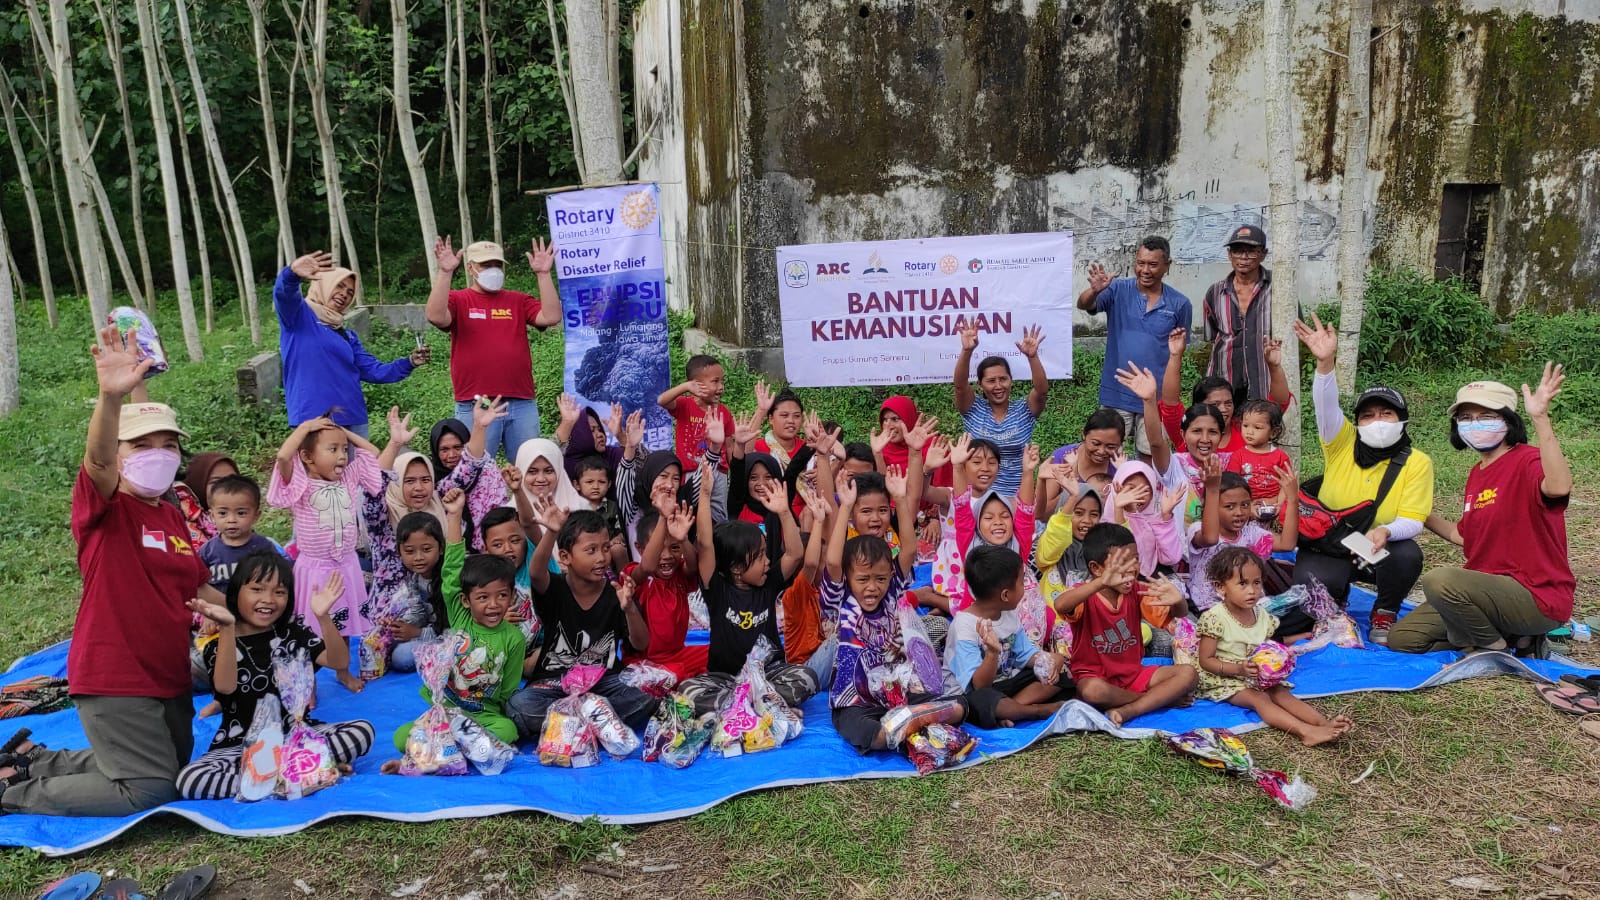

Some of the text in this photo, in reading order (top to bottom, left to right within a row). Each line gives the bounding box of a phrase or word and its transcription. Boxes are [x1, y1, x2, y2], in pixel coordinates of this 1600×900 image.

[555, 208, 614, 226] Rotary
[559, 226, 611, 240] District 3410
[561, 248, 600, 259] Rotary
[563, 256, 646, 276] Disaster Relief
[816, 262, 850, 275] ARC
[904, 261, 937, 271] Rotary
[577, 281, 661, 307] ERUPSI
[848, 286, 979, 314] BANTUAN
[567, 301, 662, 328] SEMERU
[581, 327, 612, 337] Malang
[620, 322, 664, 332] Lumajang
[615, 334, 638, 344] Jawa
[822, 357, 847, 365] Erupsi
[849, 355, 878, 364] Gunung
